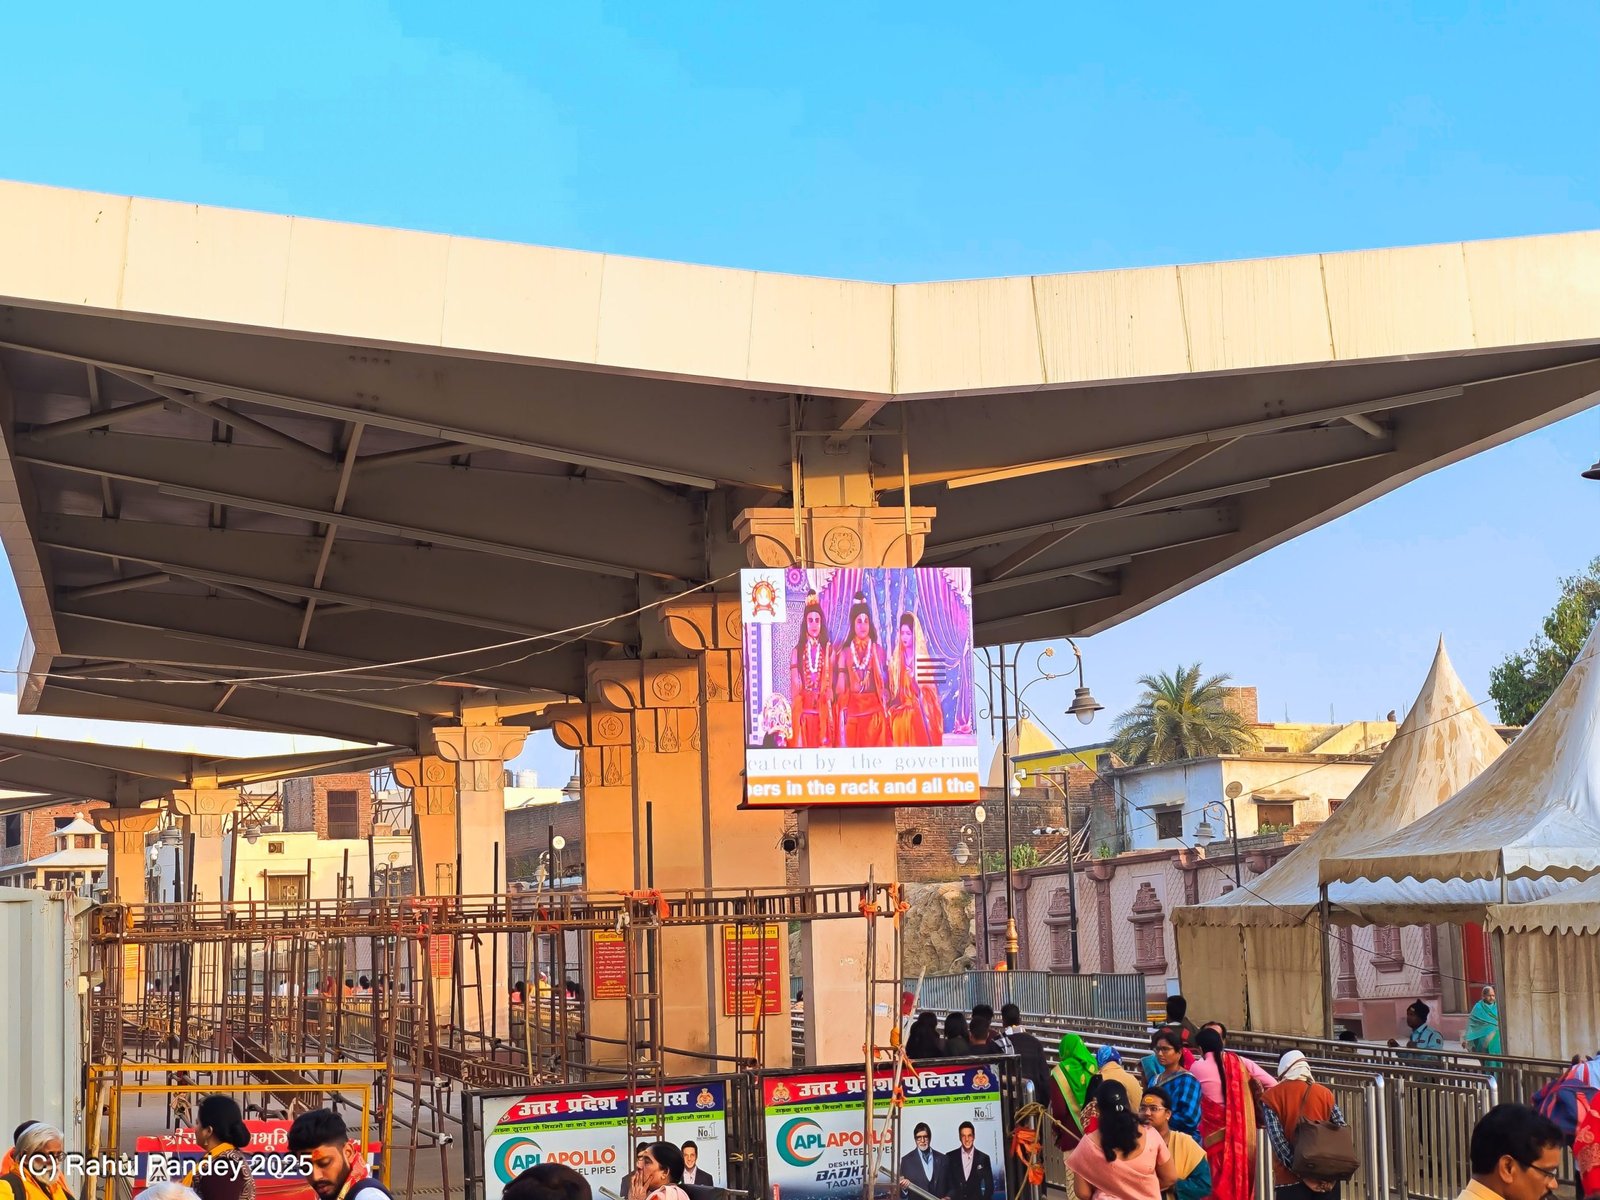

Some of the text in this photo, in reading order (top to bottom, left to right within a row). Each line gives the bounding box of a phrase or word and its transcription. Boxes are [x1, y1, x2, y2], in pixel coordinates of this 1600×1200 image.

[816, 754, 837, 773] by
[852, 752, 882, 769] the
[787, 780, 803, 796] in
[807, 779, 836, 796] the
[841, 778, 879, 795] rack
[884, 777, 917, 794] and
[922, 777, 943, 794] all
[946, 776, 975, 793] the
[796, 1080, 838, 1097] उत्तर
[902, 1071, 966, 1094] पुलिस
[516, 1099, 559, 1117] उत्तर
[566, 1094, 618, 1114] प्रदेश
[794, 1133, 827, 1149] APL
[546, 1147, 616, 1166] APOLLO
[828, 1161, 849, 1169] DESH
[592, 1165, 617, 1175] PIPES
[826, 1177, 863, 1190] TAQAT
